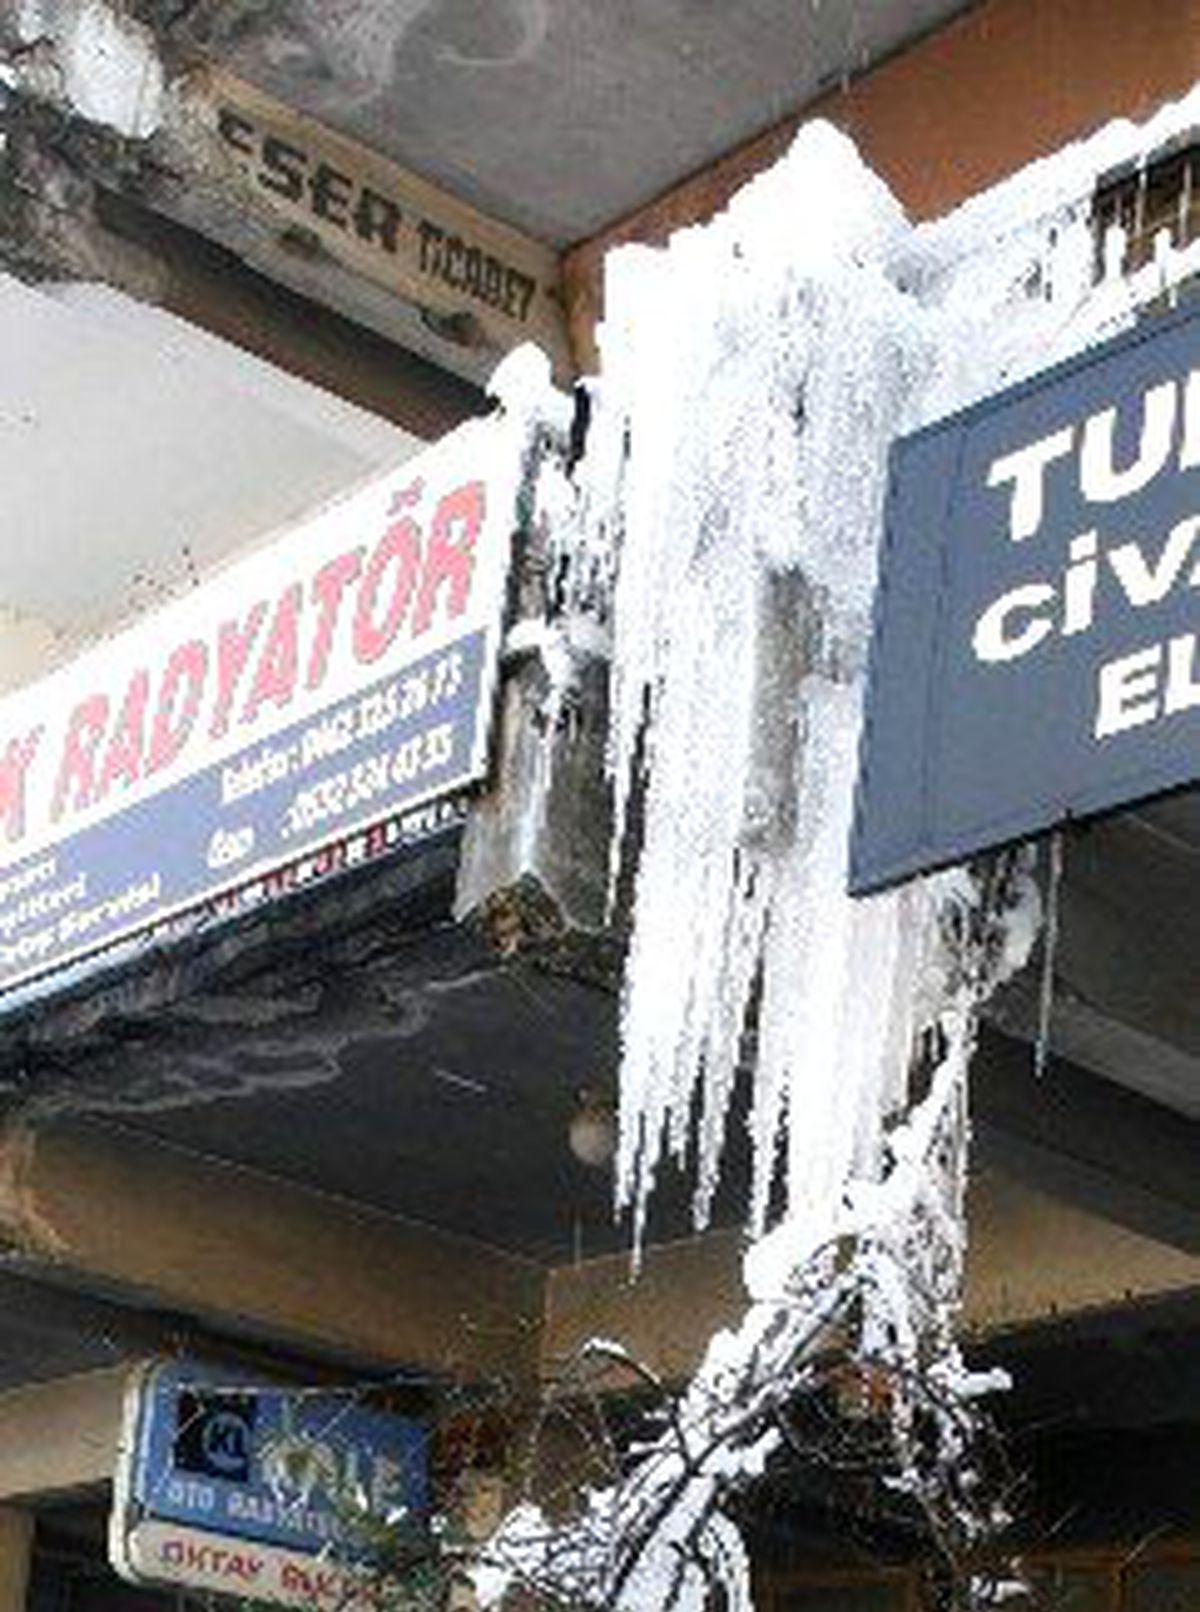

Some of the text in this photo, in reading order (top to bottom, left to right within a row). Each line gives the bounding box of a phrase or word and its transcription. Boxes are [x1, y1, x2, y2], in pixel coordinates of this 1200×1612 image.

[971, 510, 1200, 662] CİV
[50, 480, 487, 824] RADYATÖR
[167, 1478, 215, 1512] OTO
[160, 1539, 264, 1577] OKTAY
